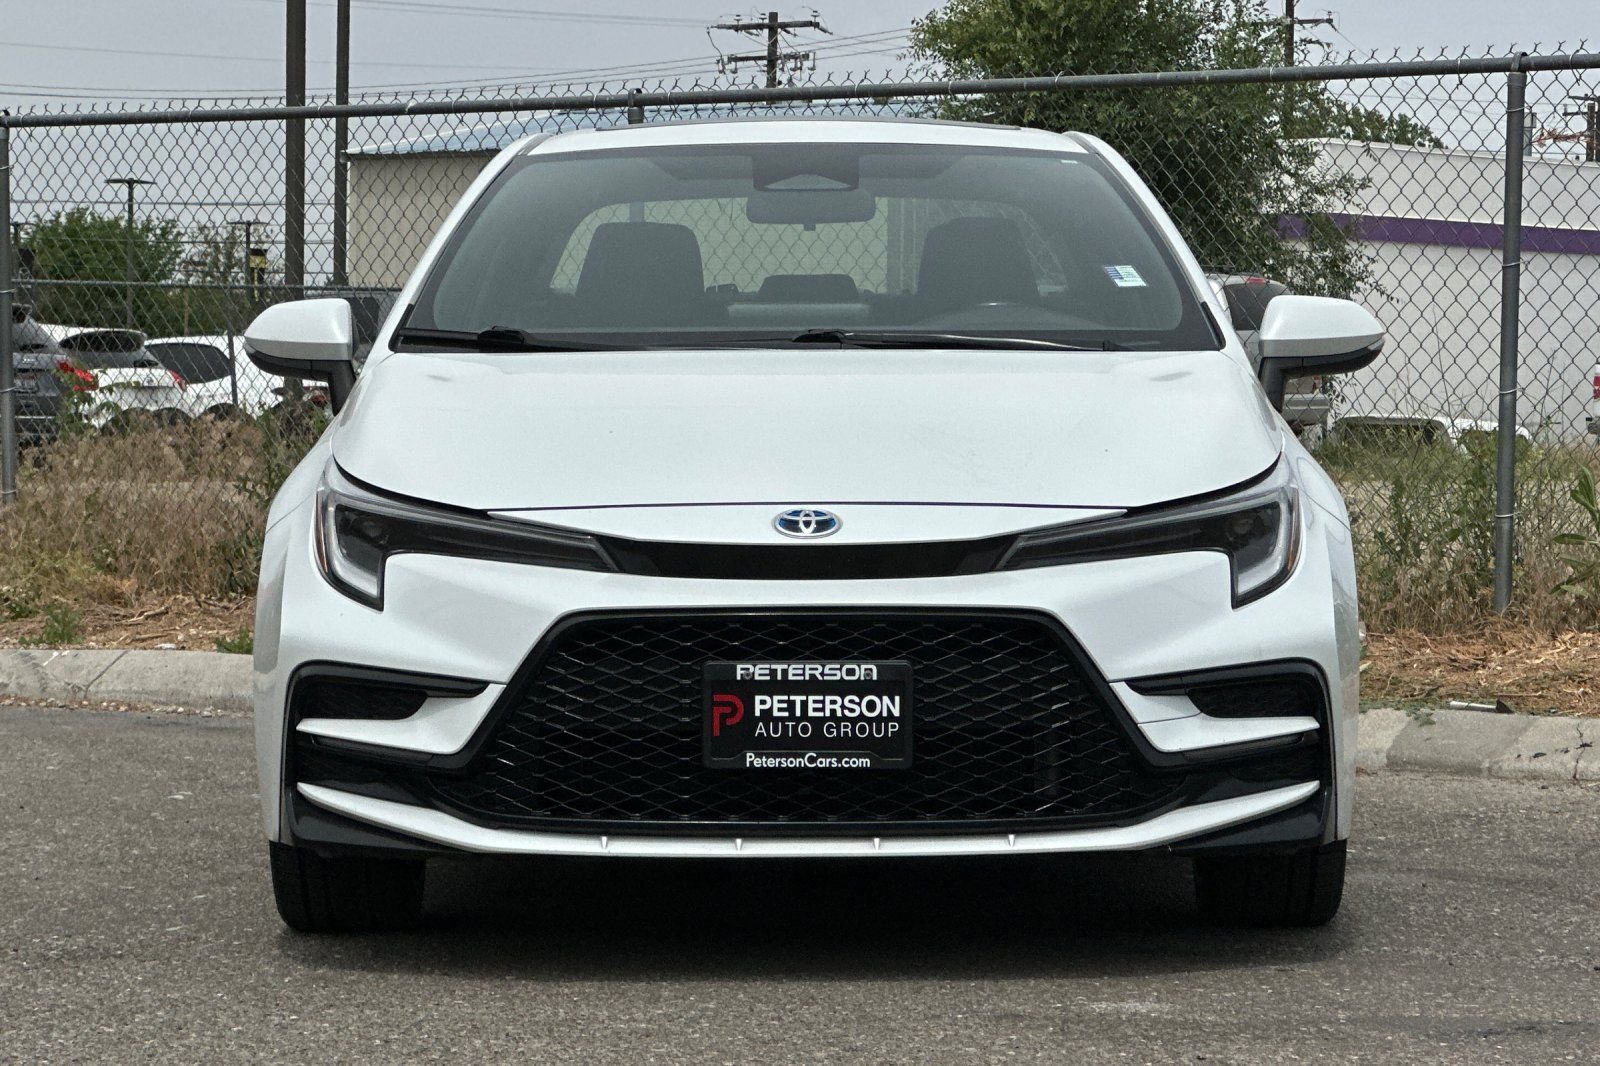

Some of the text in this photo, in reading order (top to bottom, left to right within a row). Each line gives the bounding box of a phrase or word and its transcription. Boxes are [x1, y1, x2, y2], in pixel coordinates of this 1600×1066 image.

[736, 664, 878, 681] PETERSON
[754, 695, 900, 717] PETERSON
[754, 722, 899, 738] AUTO GROUP
[746, 752, 871, 768] PetersonCars.com
